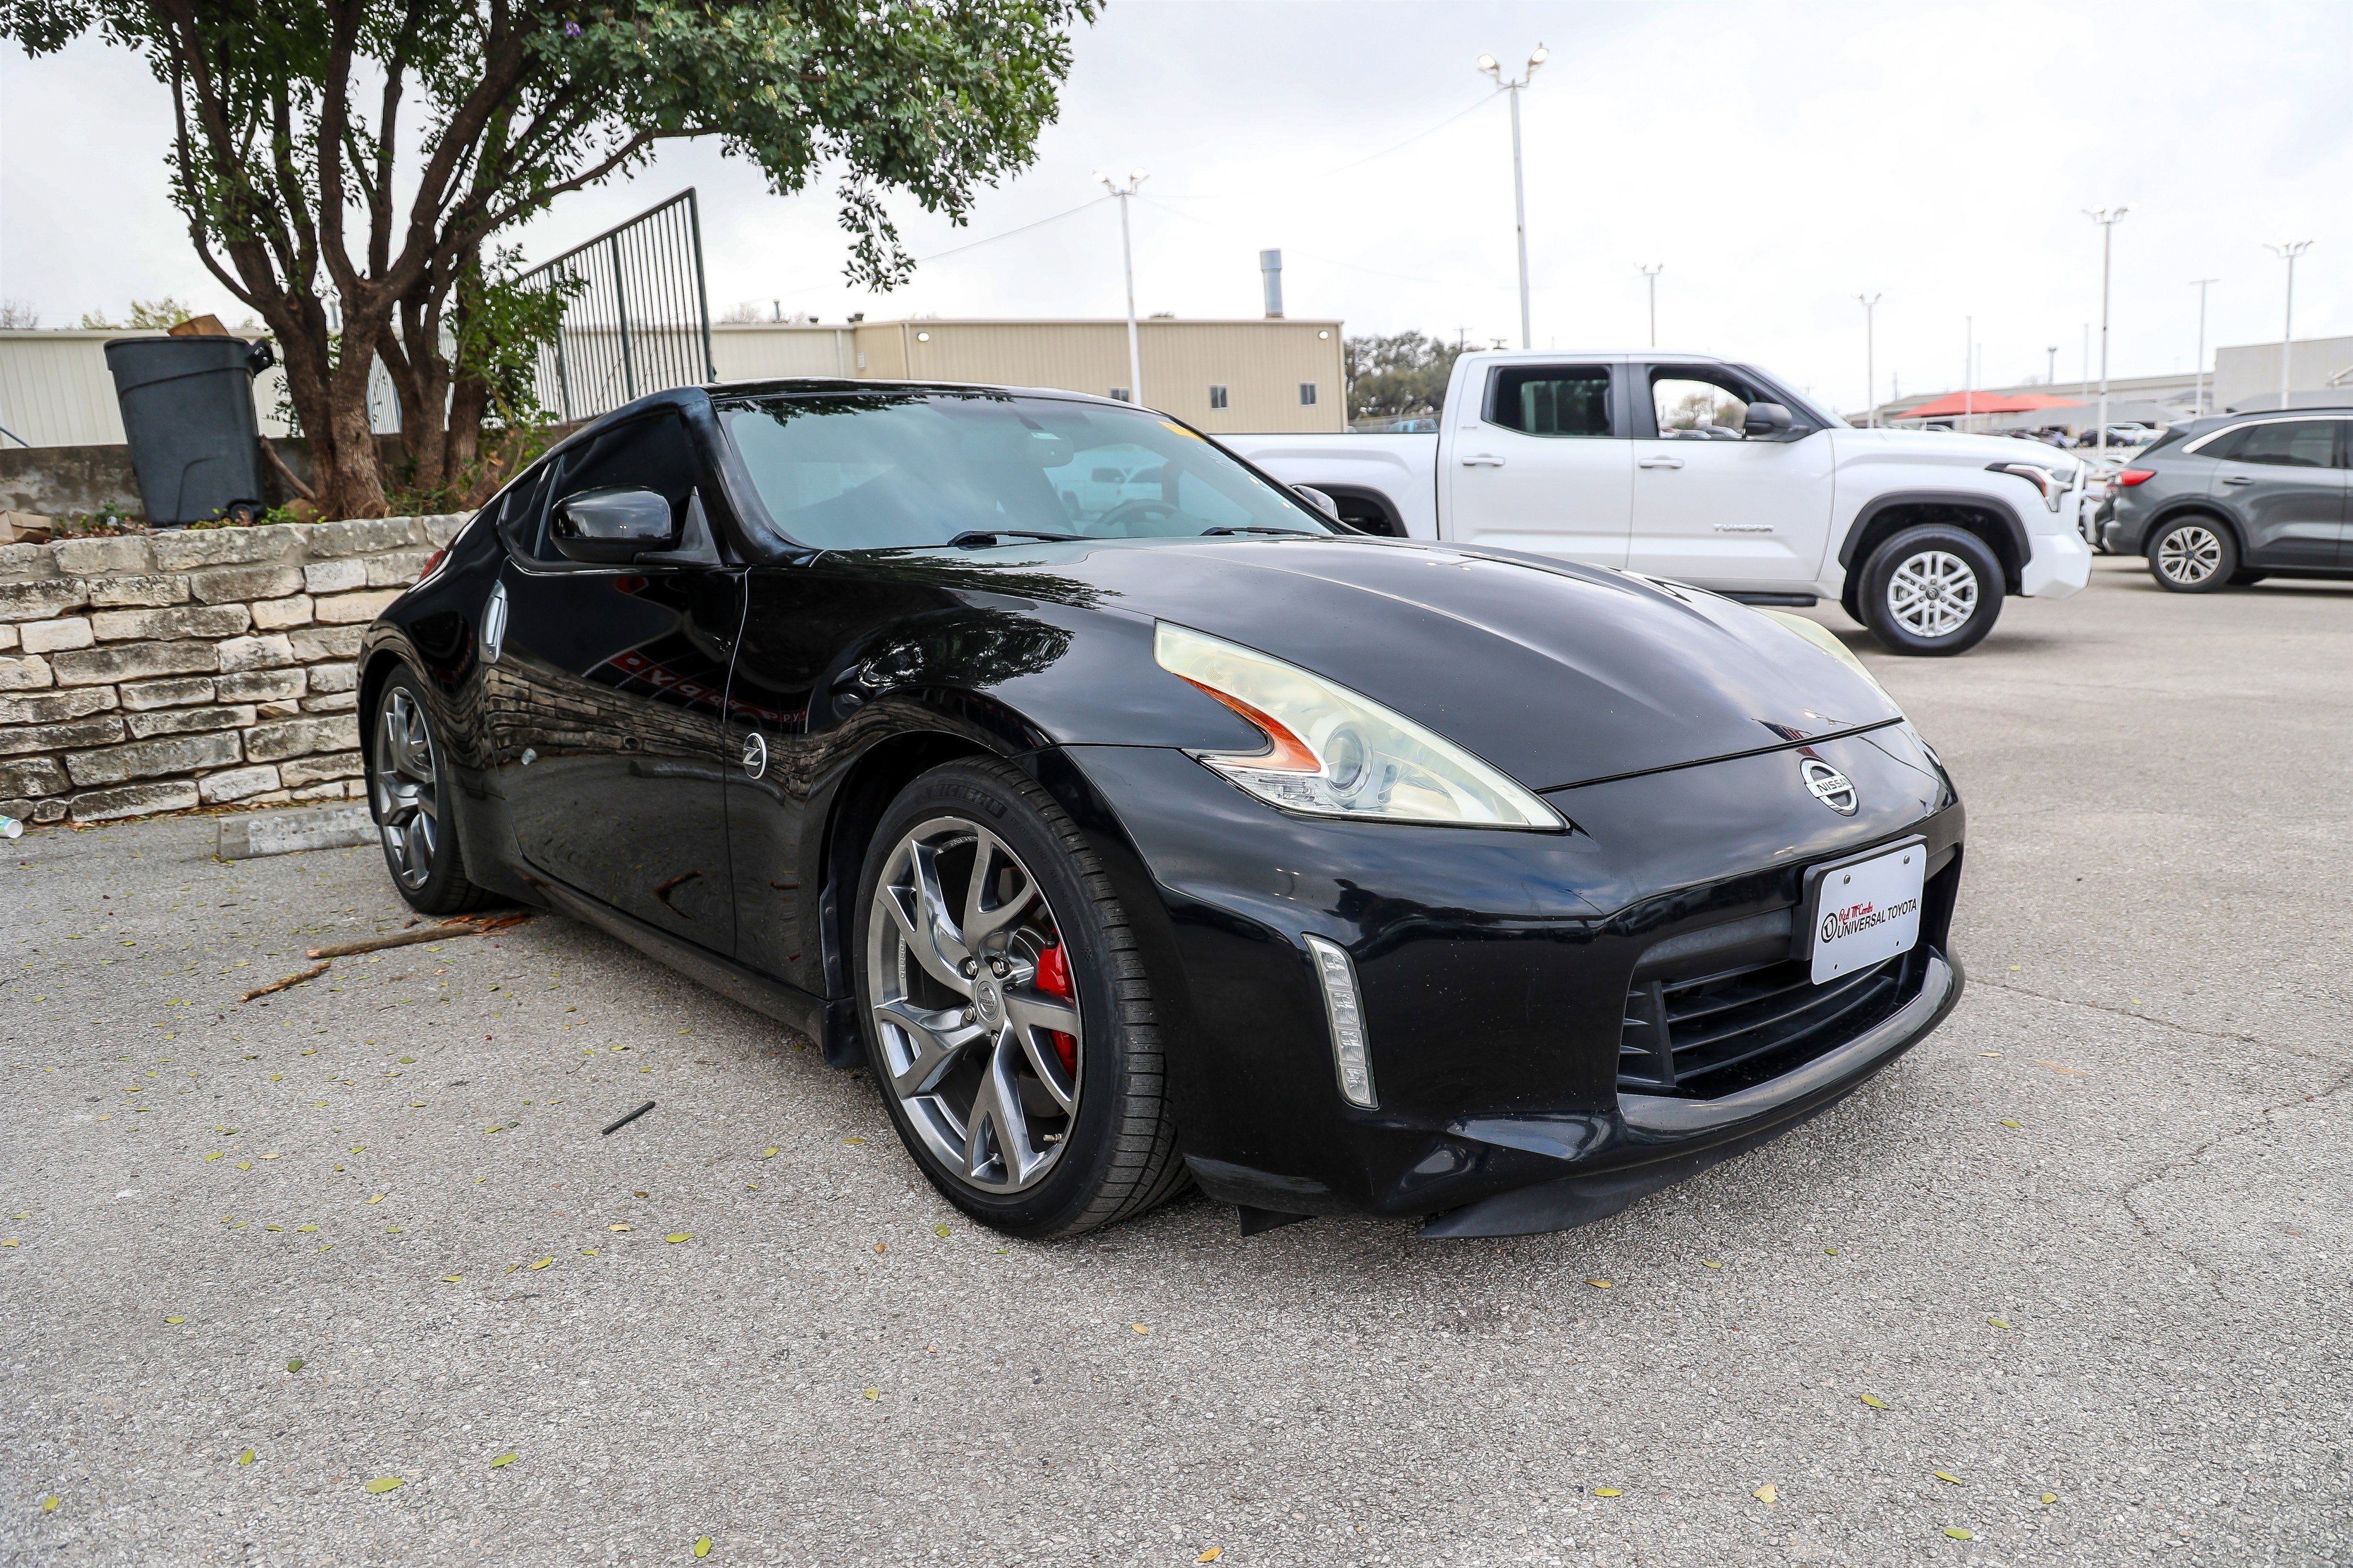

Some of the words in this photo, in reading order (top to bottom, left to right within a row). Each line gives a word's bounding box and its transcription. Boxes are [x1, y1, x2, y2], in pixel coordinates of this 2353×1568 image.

[930, 784, 1003, 815] MICHELIN
[1816, 777, 1851, 793] NISSAN
[1010, 817, 1030, 837] PILOT
[1029, 837, 1051, 866] SPORT
[1048, 868, 1063, 887] ALL
[1060, 889, 1081, 931] SEASON
[1837, 910, 1886, 939] UNIVERSAL
[1888, 898, 1917, 921] TOYOTA
[1839, 907, 1850, 926] Red
